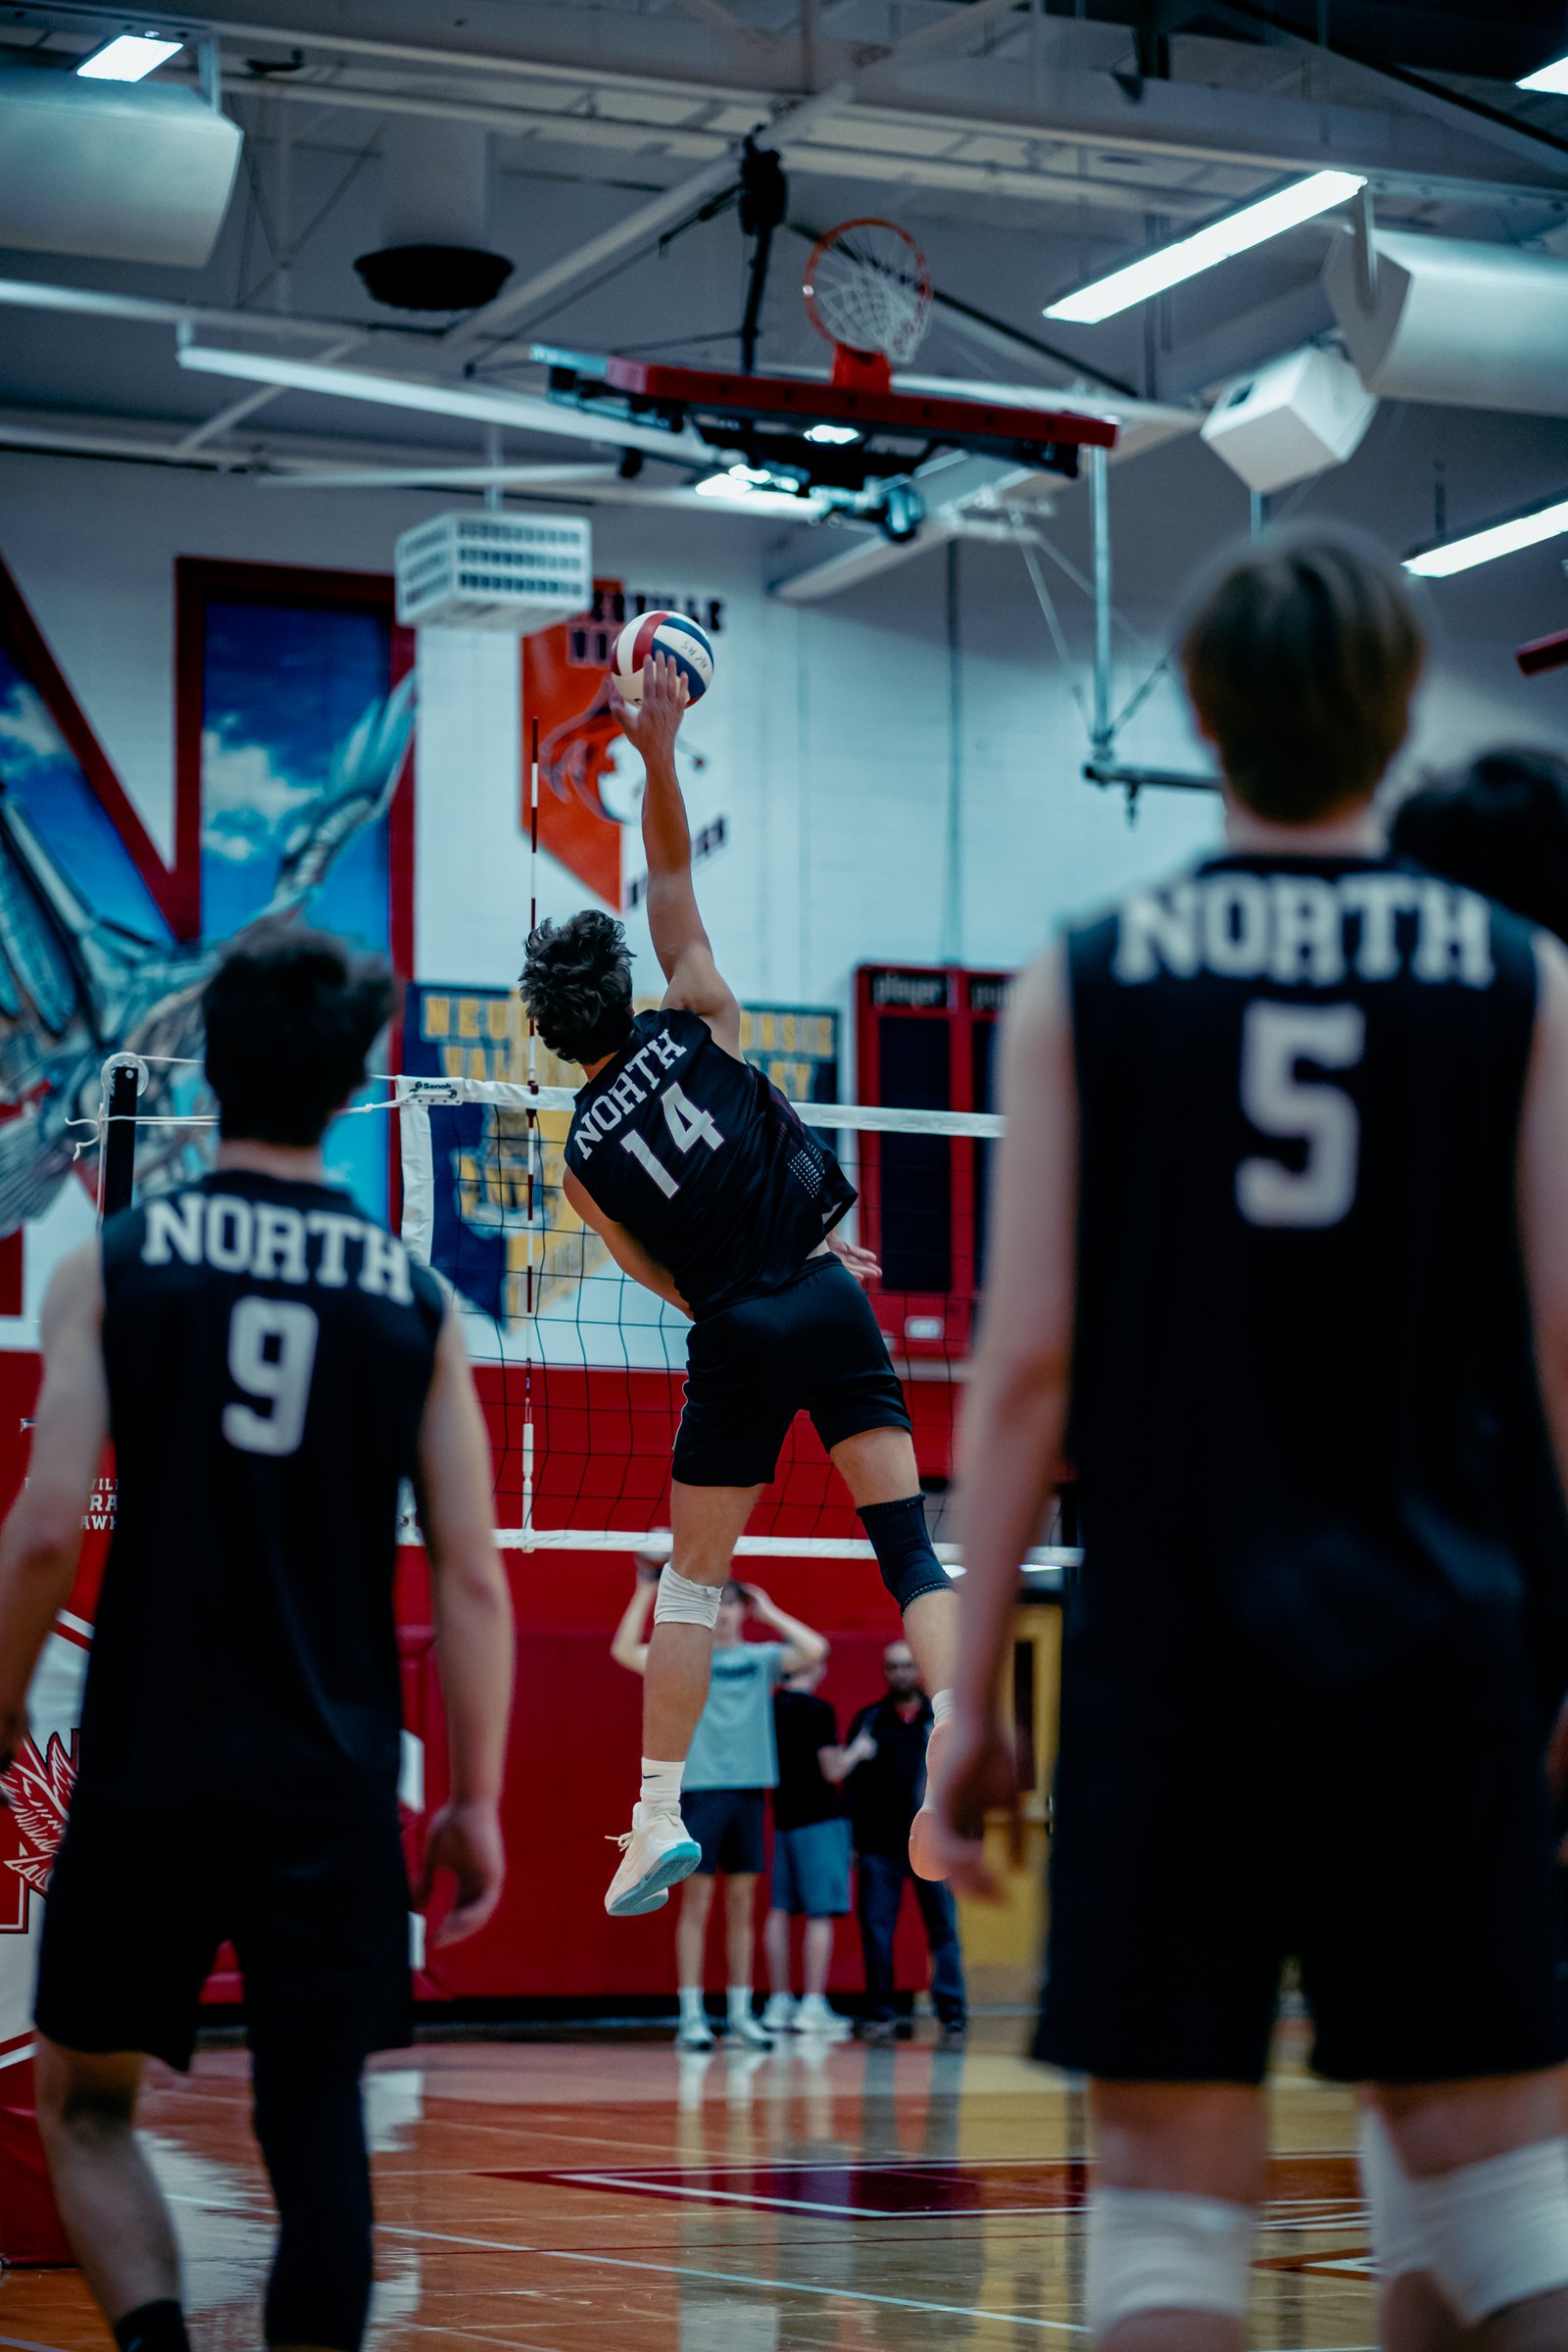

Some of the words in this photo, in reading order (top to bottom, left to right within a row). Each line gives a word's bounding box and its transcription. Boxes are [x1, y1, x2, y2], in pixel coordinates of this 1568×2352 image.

[1111, 869, 1495, 991] NORTH
[574, 1029, 687, 1160] NORTH
[620, 1081, 724, 1199] 14
[1235, 997, 1366, 1230] 5
[141, 1192, 414, 1305] NORTH
[221, 1295, 318, 1456] 9
